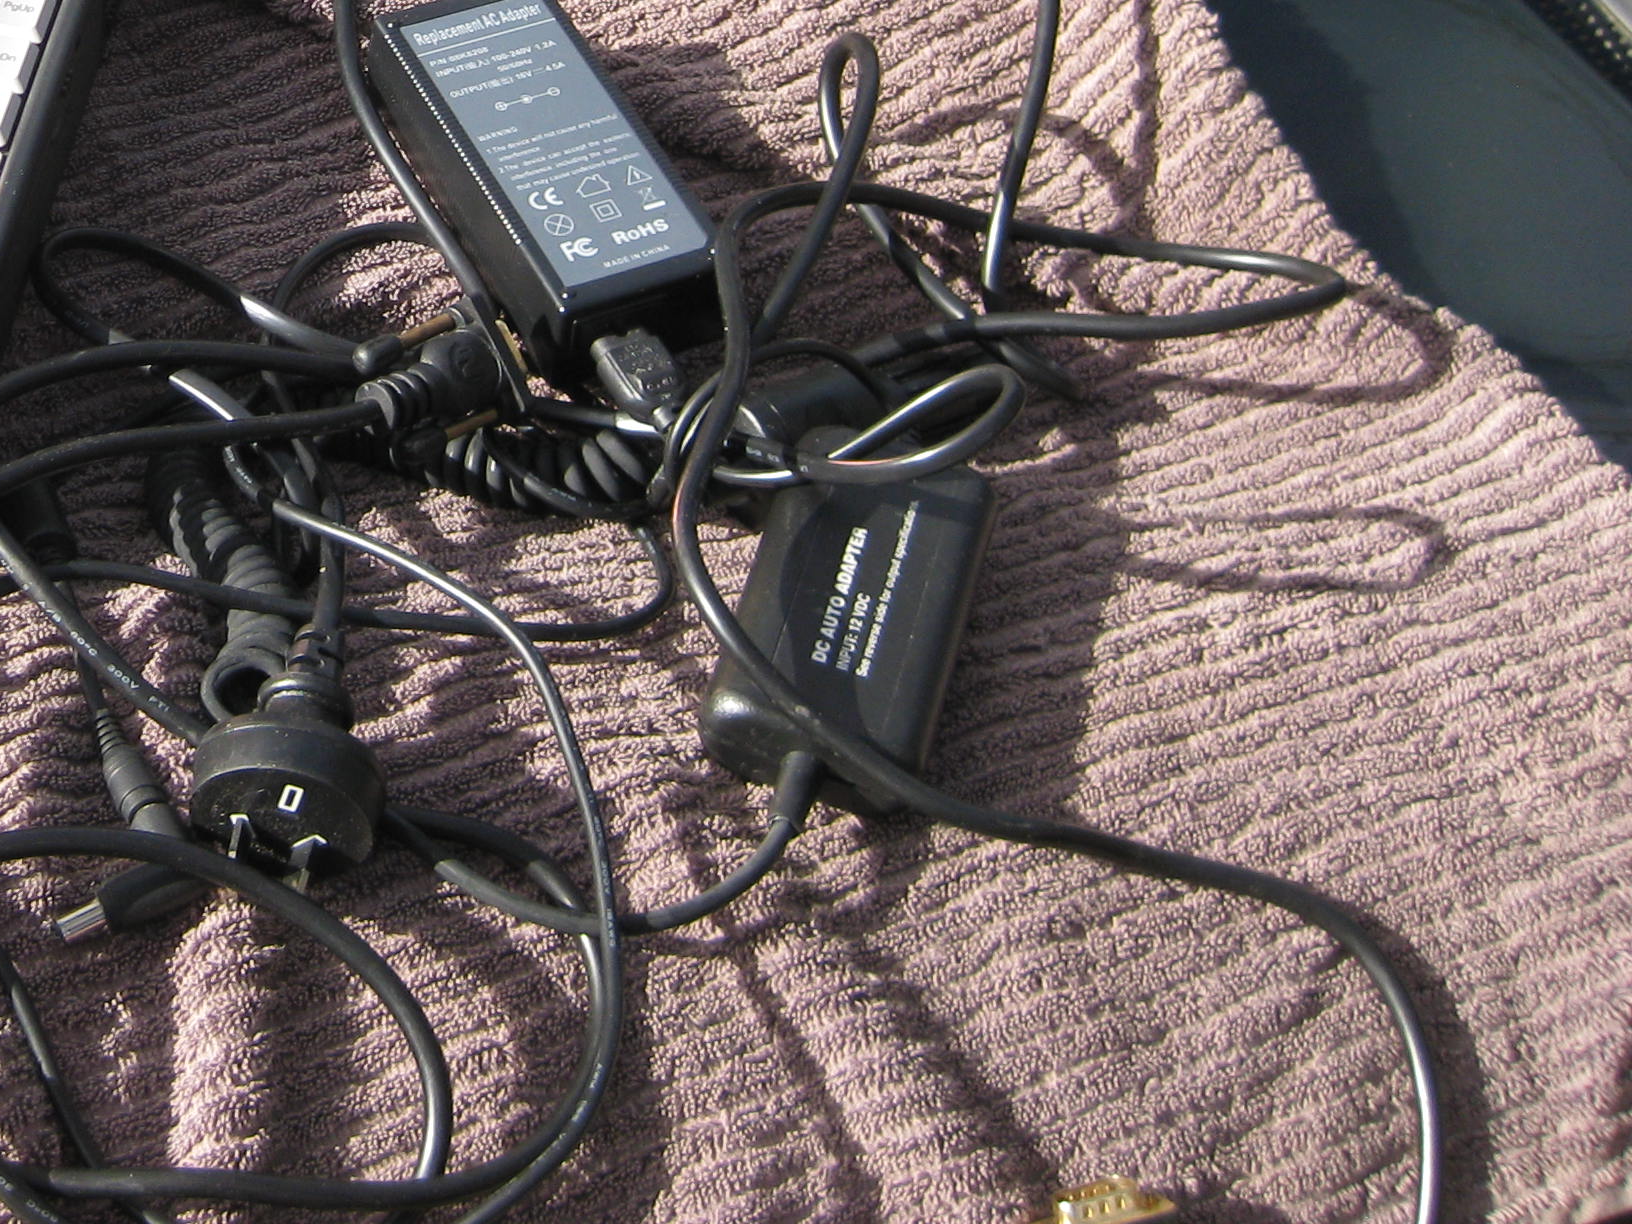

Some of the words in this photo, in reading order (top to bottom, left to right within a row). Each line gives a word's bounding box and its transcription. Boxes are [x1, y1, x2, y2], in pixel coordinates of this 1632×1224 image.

[3, 0, 35, 15] PgUp
[413, 17, 485, 46] Replacement
[481, 13, 501, 29] AC
[500, 3, 542, 24] Adapter
[611, 218, 669, 245] RoHS
[602, 255, 631, 268] MADE
[630, 251, 641, 261] IN
[641, 243, 671, 258] CHINA
[834, 526, 869, 596] ADAPTER
[820, 595, 846, 640] AUTO
[854, 591, 872, 618] VDC
[848, 618, 863, 633] 12
[855, 657, 872, 677] See
[864, 622, 883, 658] reverse
[874, 601, 889, 624] side
[811, 638, 832, 665] DC
